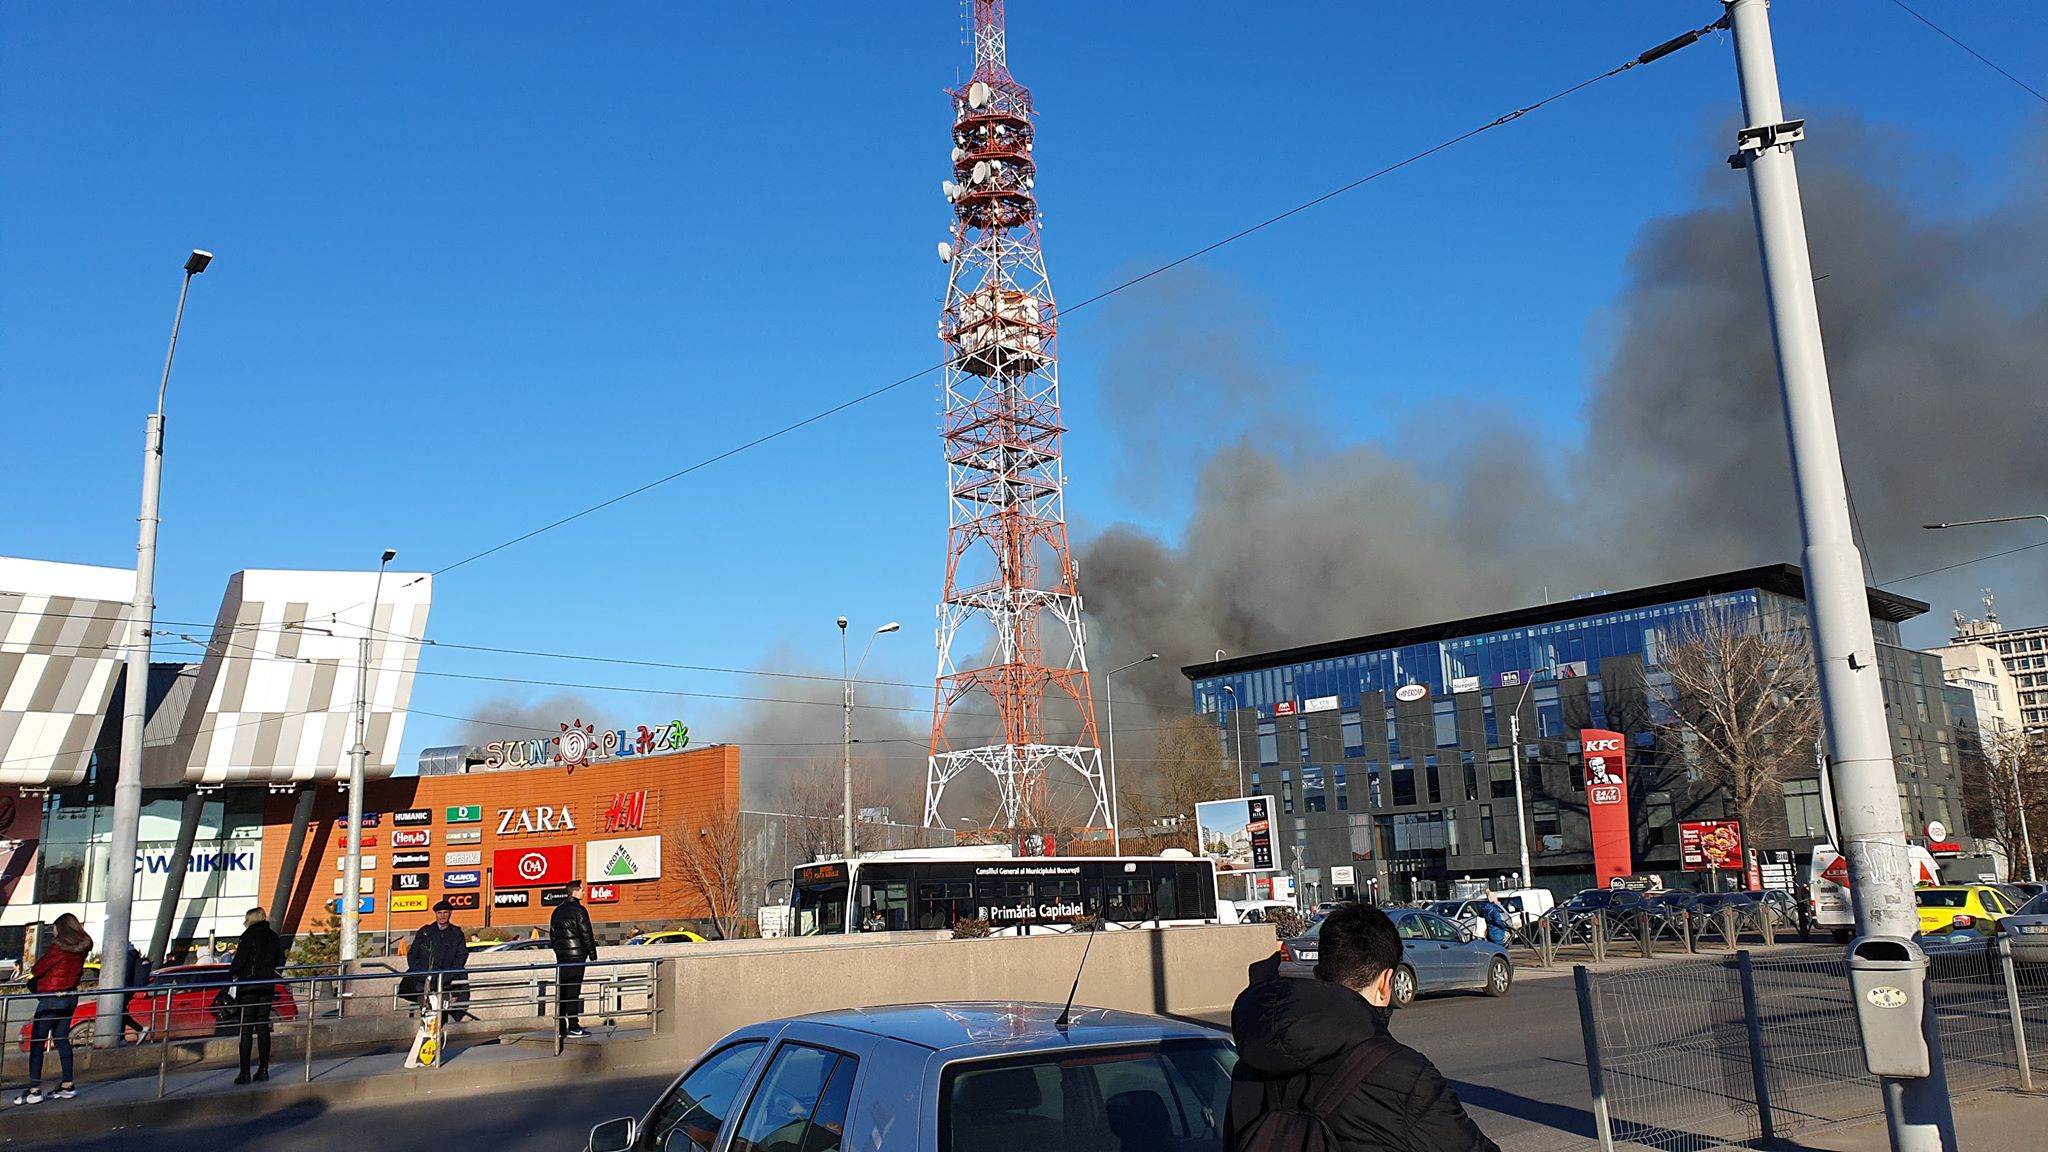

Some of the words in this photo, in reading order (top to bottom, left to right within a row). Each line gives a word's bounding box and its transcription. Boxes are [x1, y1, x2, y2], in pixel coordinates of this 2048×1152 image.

[486, 738, 550, 768] SUN
[598, 720, 689, 760] PLAZA
[1585, 739, 1620, 752] KFC
[1596, 789, 1616, 797] 24/7
[395, 812, 428, 821] HUMANIC
[496, 805, 576, 835] ZARA
[396, 831, 425, 844] Hervis
[446, 853, 480, 864] Bershka
[603, 851, 620, 875] LEROY
[618, 844, 638, 873] MERLIN
[447, 873, 475, 881] FLANCO
[999, 867, 1019, 875] General
[1026, 867, 1056, 875] Municipiului
[400, 874, 419, 888] KVL
[393, 899, 422, 908] ALTEX
[448, 895, 472, 906] CCC
[991, 904, 1036, 920] Primăria
[1039, 902, 1083, 920] Capitalei
